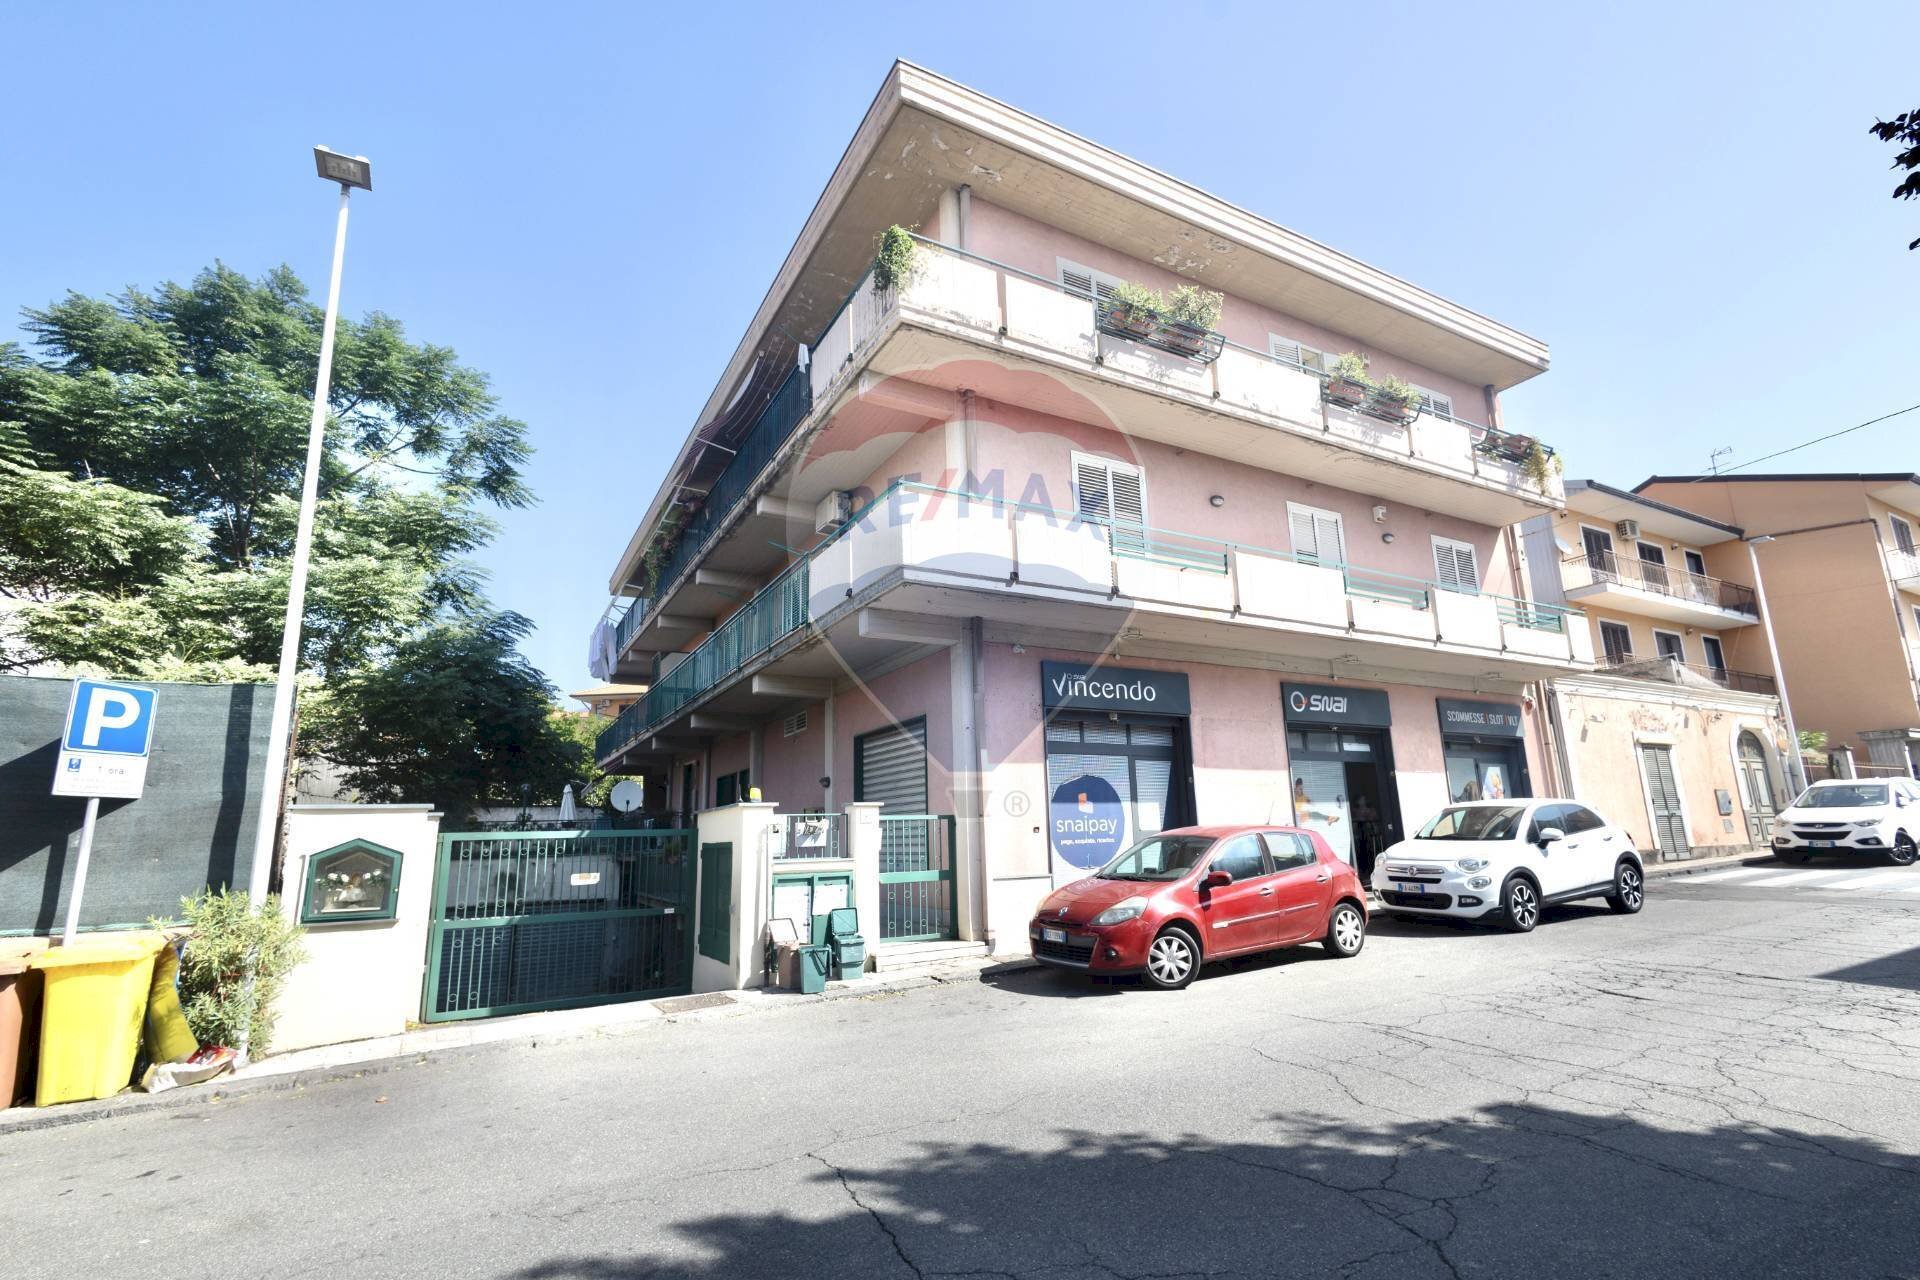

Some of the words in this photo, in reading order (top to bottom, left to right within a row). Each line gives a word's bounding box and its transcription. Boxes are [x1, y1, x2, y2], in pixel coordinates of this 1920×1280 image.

[1052, 673, 1156, 702] Vincendo
[81, 687, 140, 747] P
[1446, 710, 1485, 724] SCOMMESSE
[1056, 815, 1117, 835] snaipay
